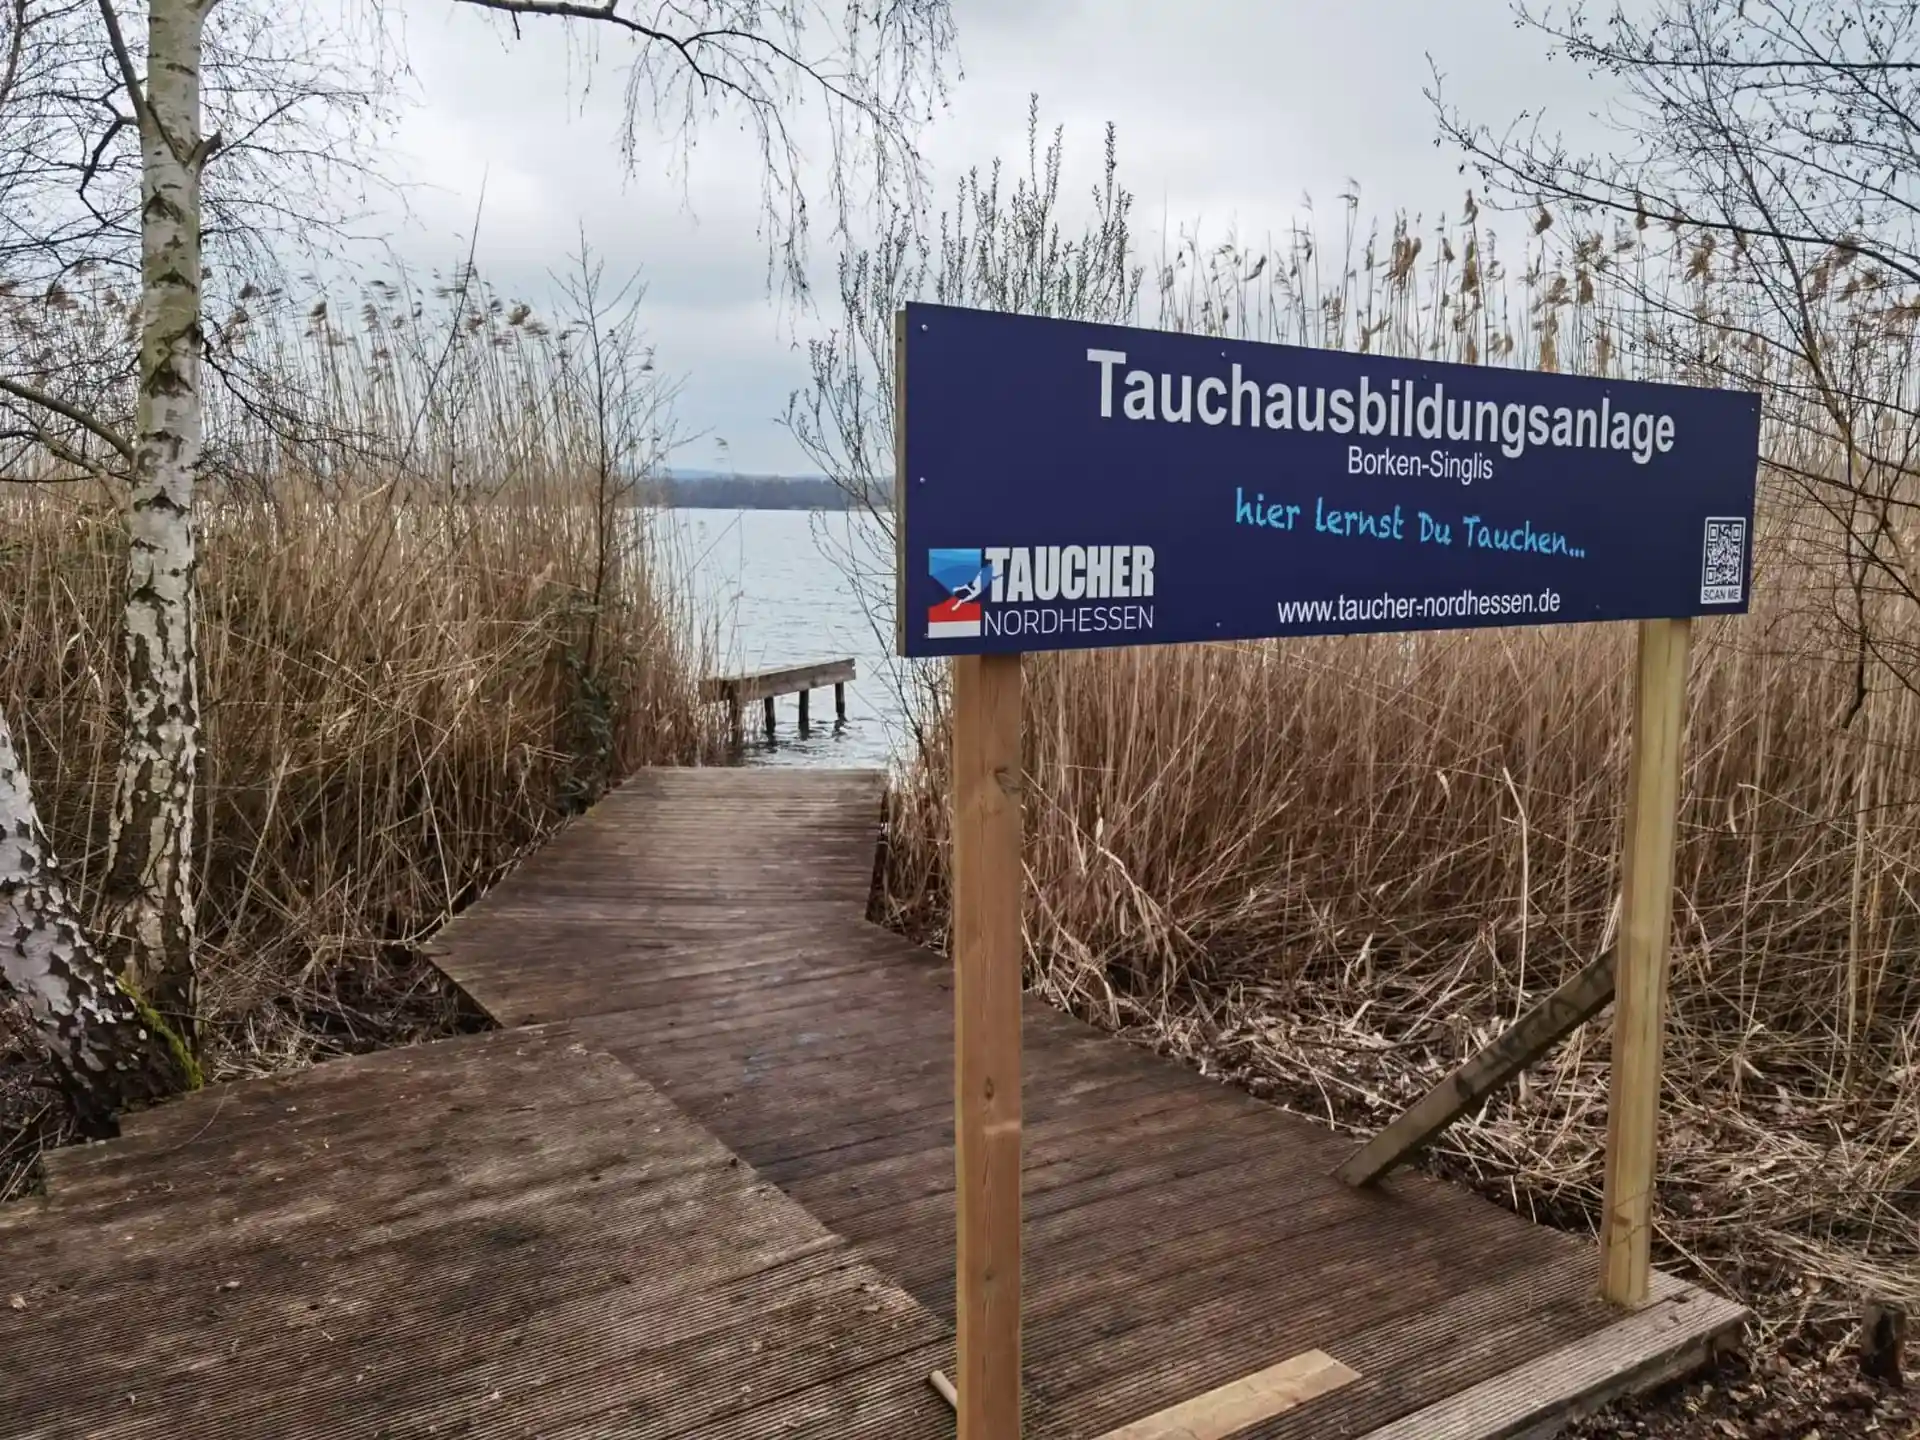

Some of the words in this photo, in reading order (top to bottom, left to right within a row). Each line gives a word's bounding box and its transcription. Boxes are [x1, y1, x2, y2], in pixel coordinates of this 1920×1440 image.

[1087, 348, 1675, 465] Tauchausbildungsanlage
[1346, 445, 1493, 485] Borken-Singlis
[1235, 487, 1301, 530] hier
[1315, 496, 1405, 540] lernst
[1417, 511, 1452, 546] Du
[1463, 515, 1585, 558] Tauchen...
[984, 545, 1155, 602] TAUCHER
[1277, 587, 1561, 623] www.taucher-nordhessen.de
[1703, 589, 1726, 600] SCAN
[1727, 588, 1740, 600] ME
[984, 605, 1154, 636] NORDHESSEN
